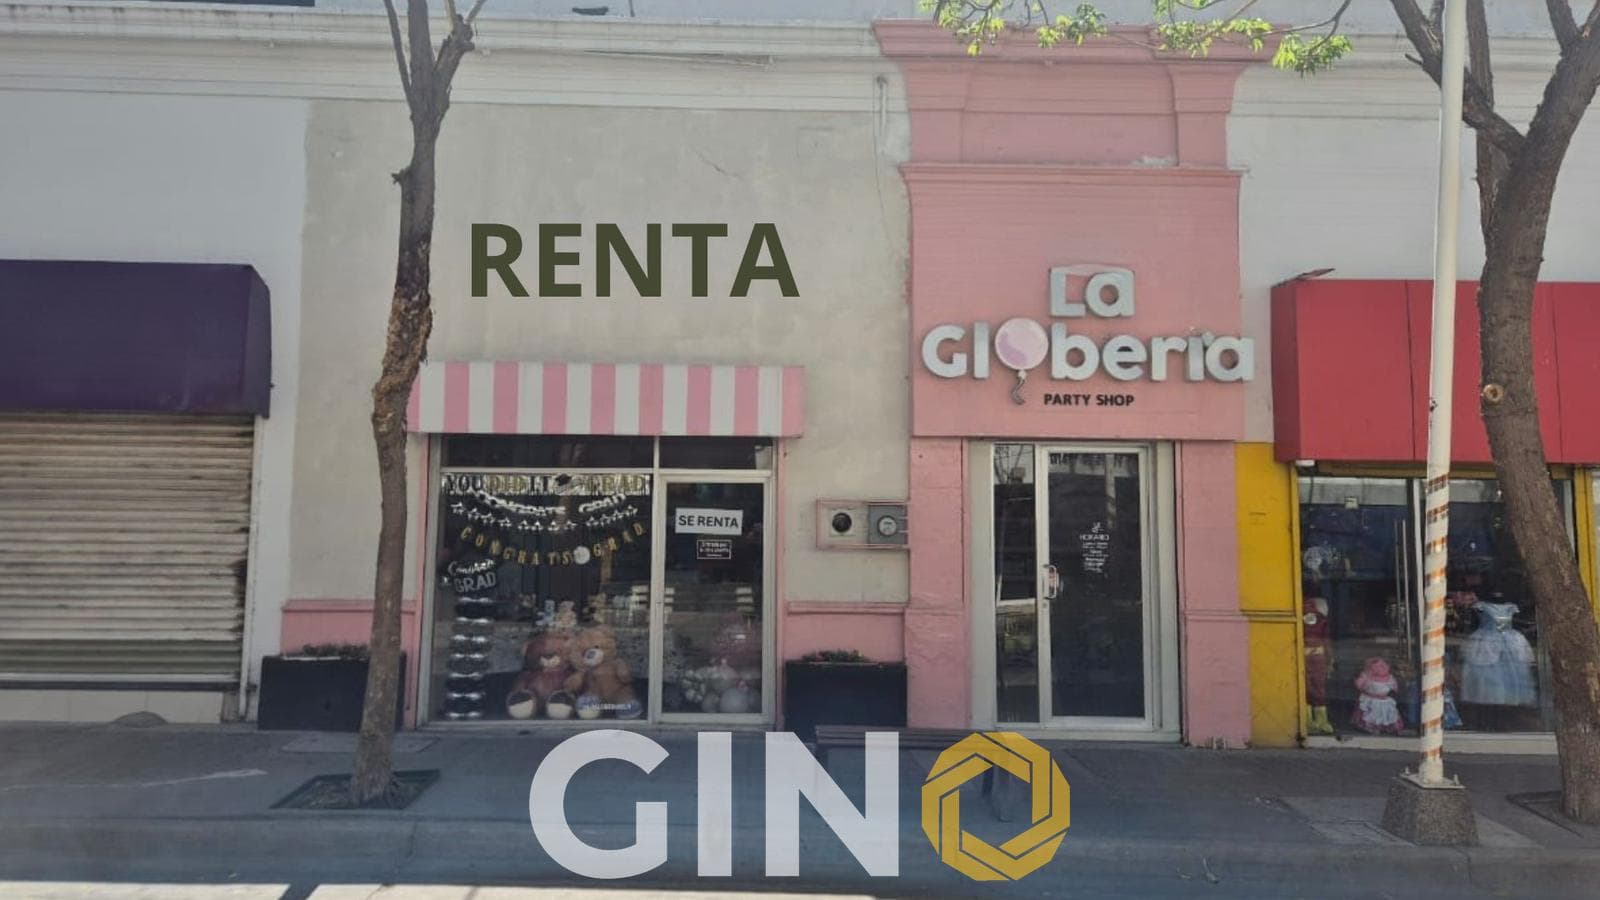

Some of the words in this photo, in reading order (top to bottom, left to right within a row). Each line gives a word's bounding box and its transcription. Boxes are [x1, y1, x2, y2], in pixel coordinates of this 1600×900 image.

[1049, 267, 1135, 318] La
[1043, 393, 1091, 406] PARTY
[1096, 393, 1135, 407] SHOP
[678, 514, 695, 526] SE
[697, 514, 739, 528] RENTA
[461, 526, 573, 566] CONGRATS
[453, 571, 496, 593] GRAD
